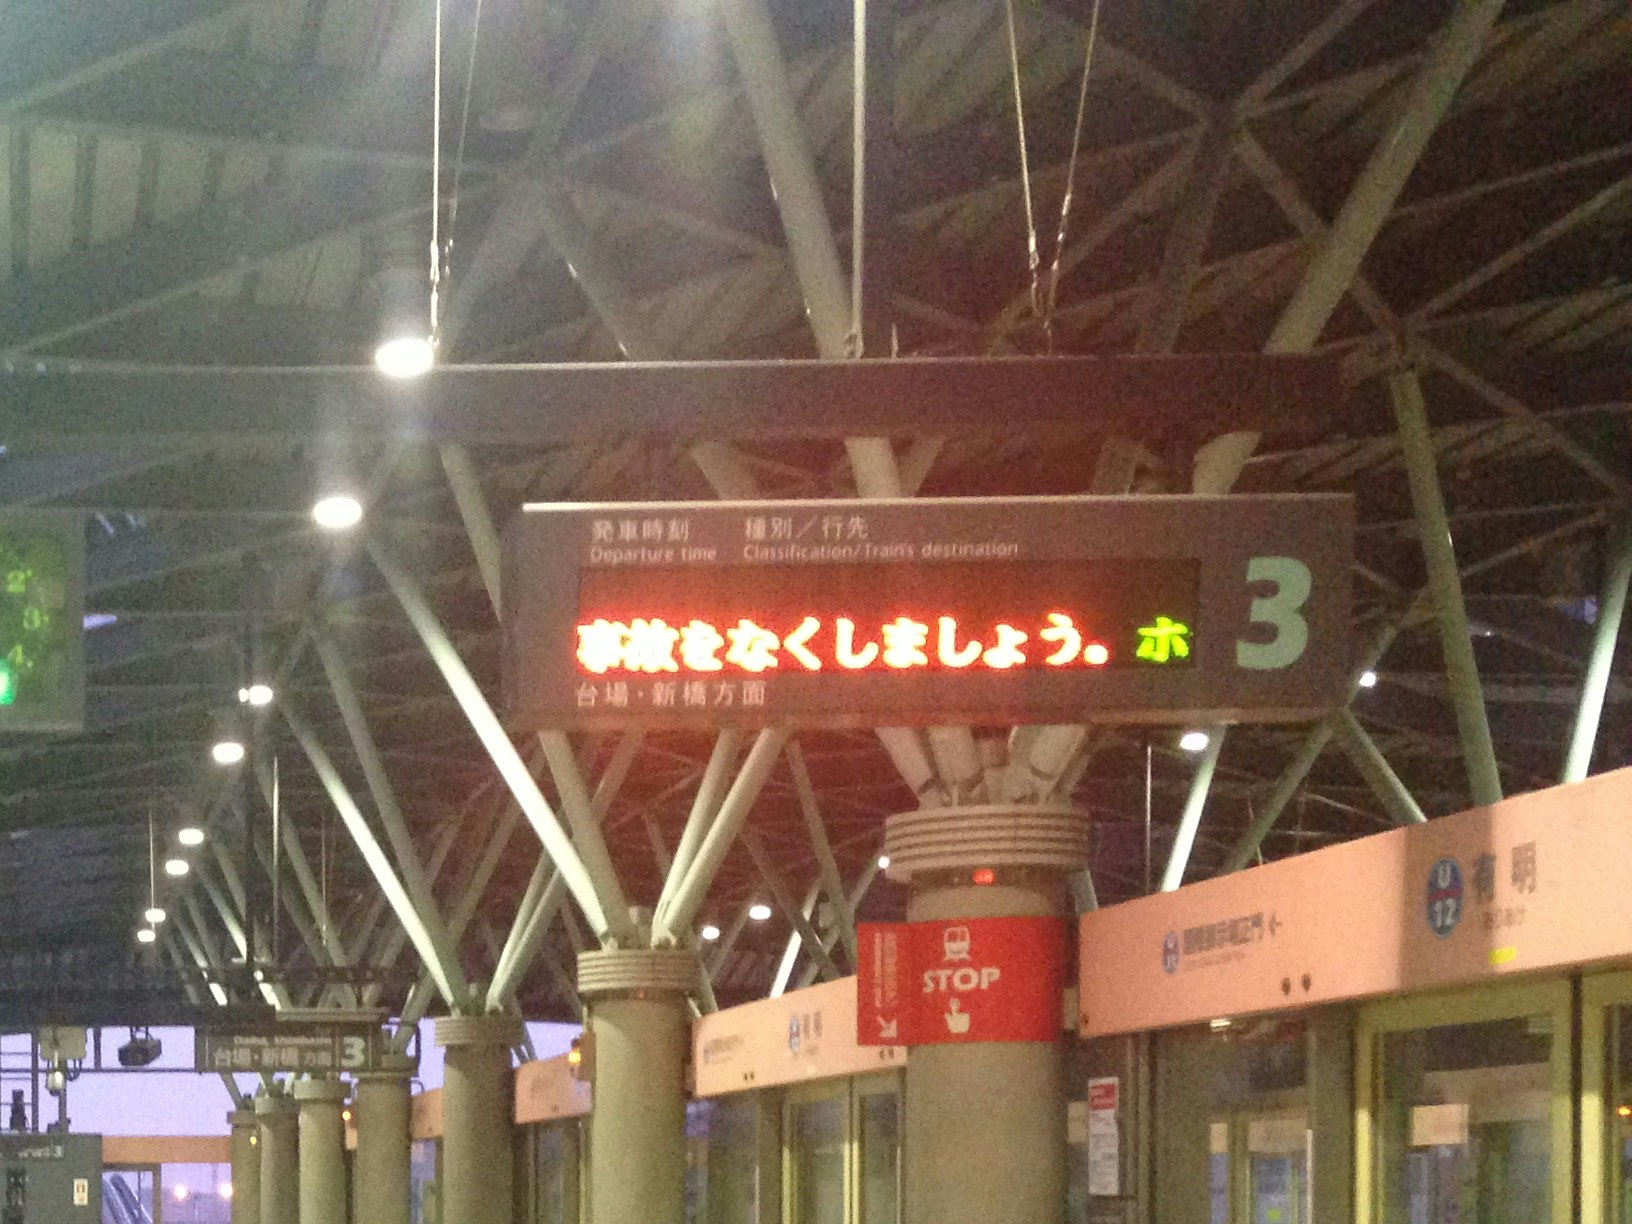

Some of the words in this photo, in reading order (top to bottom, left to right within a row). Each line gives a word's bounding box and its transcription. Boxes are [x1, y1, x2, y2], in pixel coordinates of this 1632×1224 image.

[589, 546, 673, 566] Departure
[681, 544, 716, 562] time
[921, 541, 1019, 559] destination
[1235, 555, 1313, 671] 3
[1437, 863, 1451, 888] U
[1434, 898, 1457, 929] 12
[923, 966, 1001, 993] STOP
[341, 1036, 365, 1067] 3
